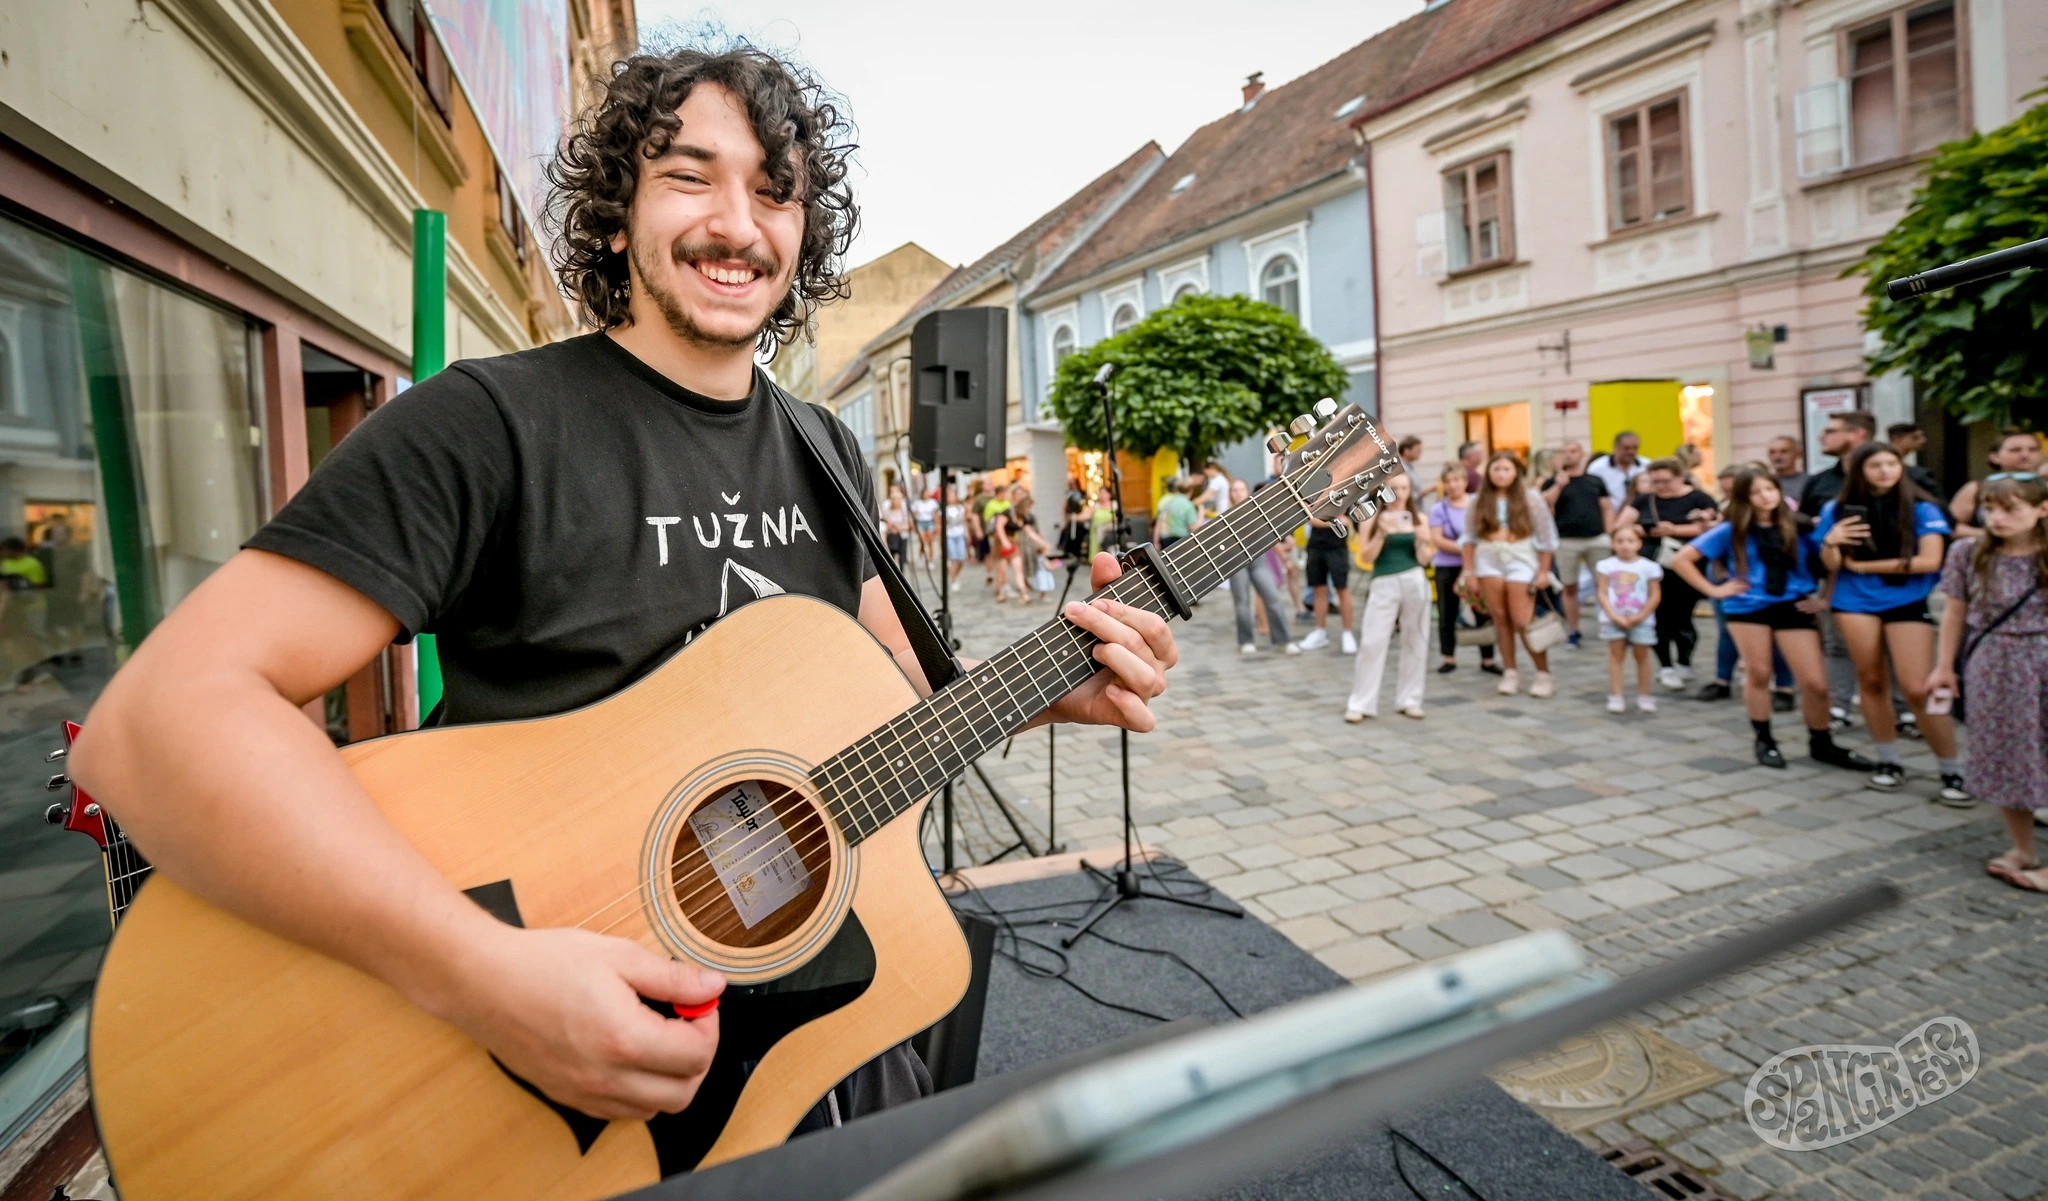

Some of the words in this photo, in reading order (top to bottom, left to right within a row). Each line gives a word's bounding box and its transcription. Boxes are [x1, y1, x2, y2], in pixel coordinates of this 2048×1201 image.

[1365, 421, 1390, 454] Taylor
[645, 491, 818, 566] TUŽNA
[731, 789, 759, 833] Taylor
